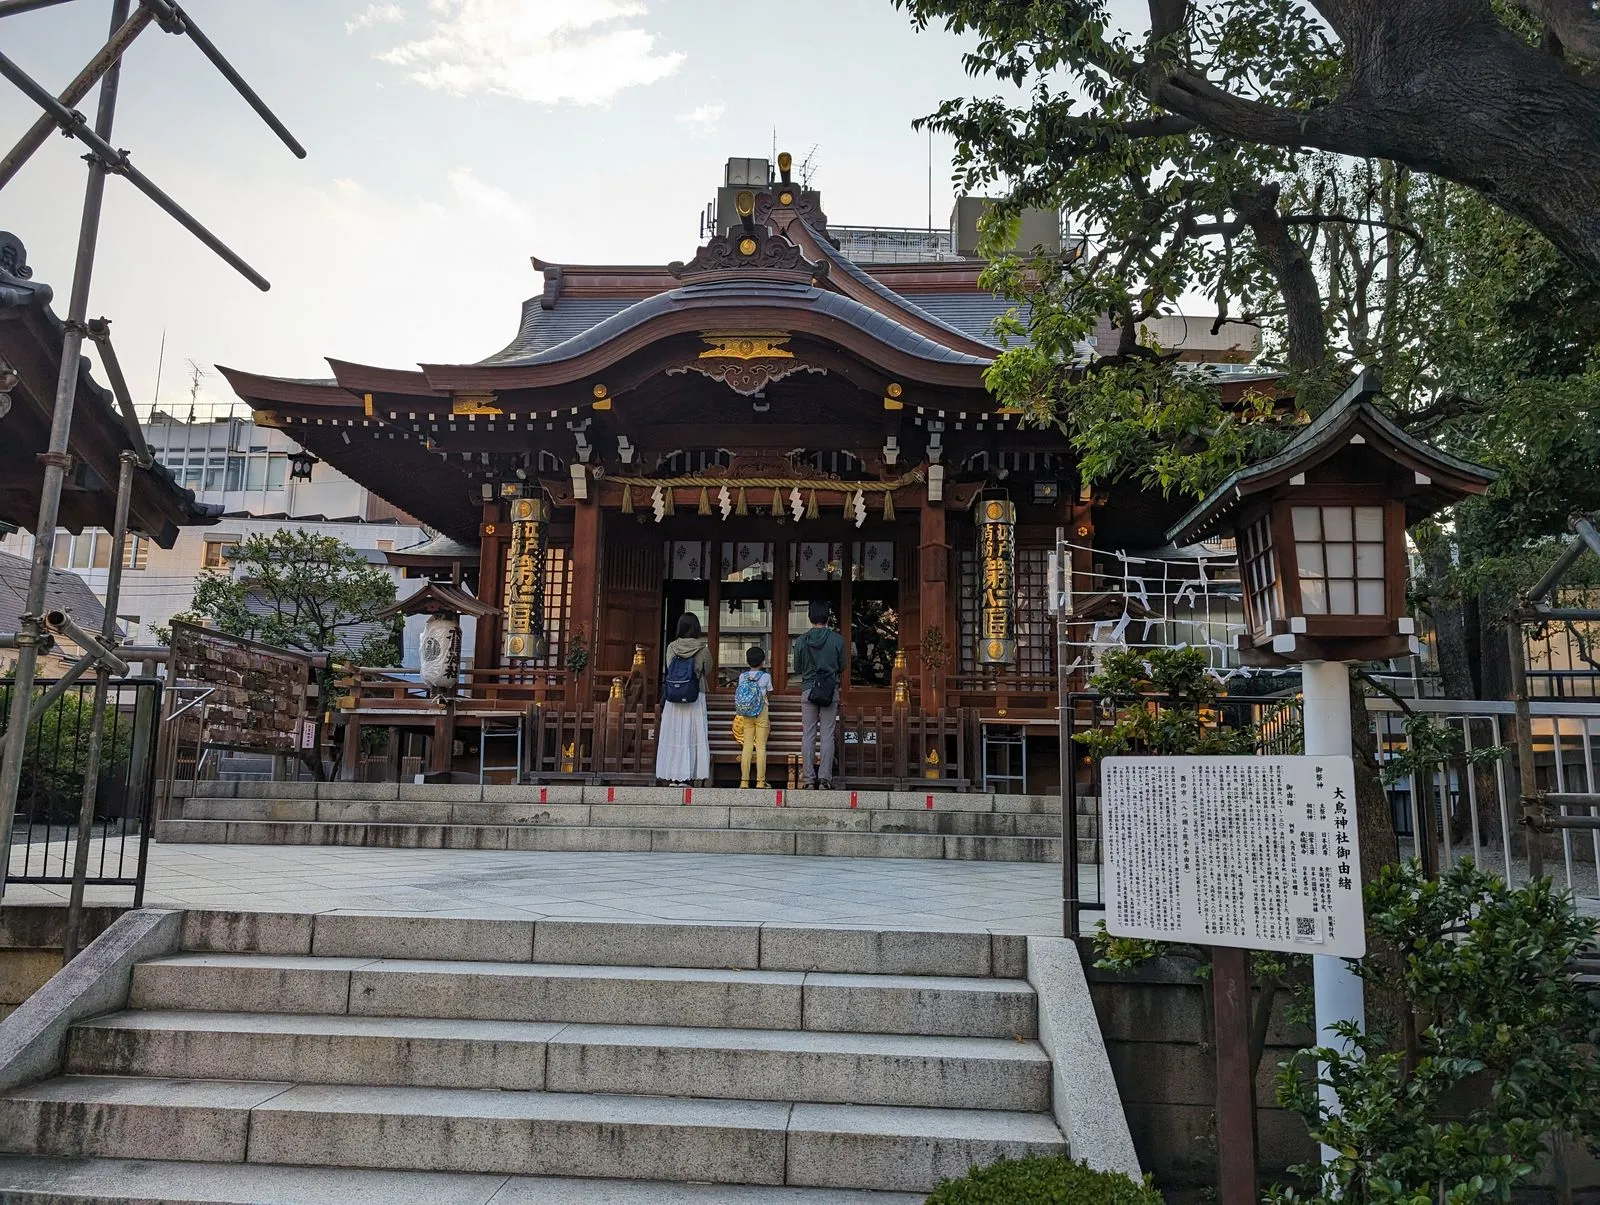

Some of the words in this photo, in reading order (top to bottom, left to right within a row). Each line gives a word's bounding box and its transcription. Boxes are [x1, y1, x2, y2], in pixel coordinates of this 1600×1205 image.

[1332, 786, 1352, 890] 大鳥神社御由緒
